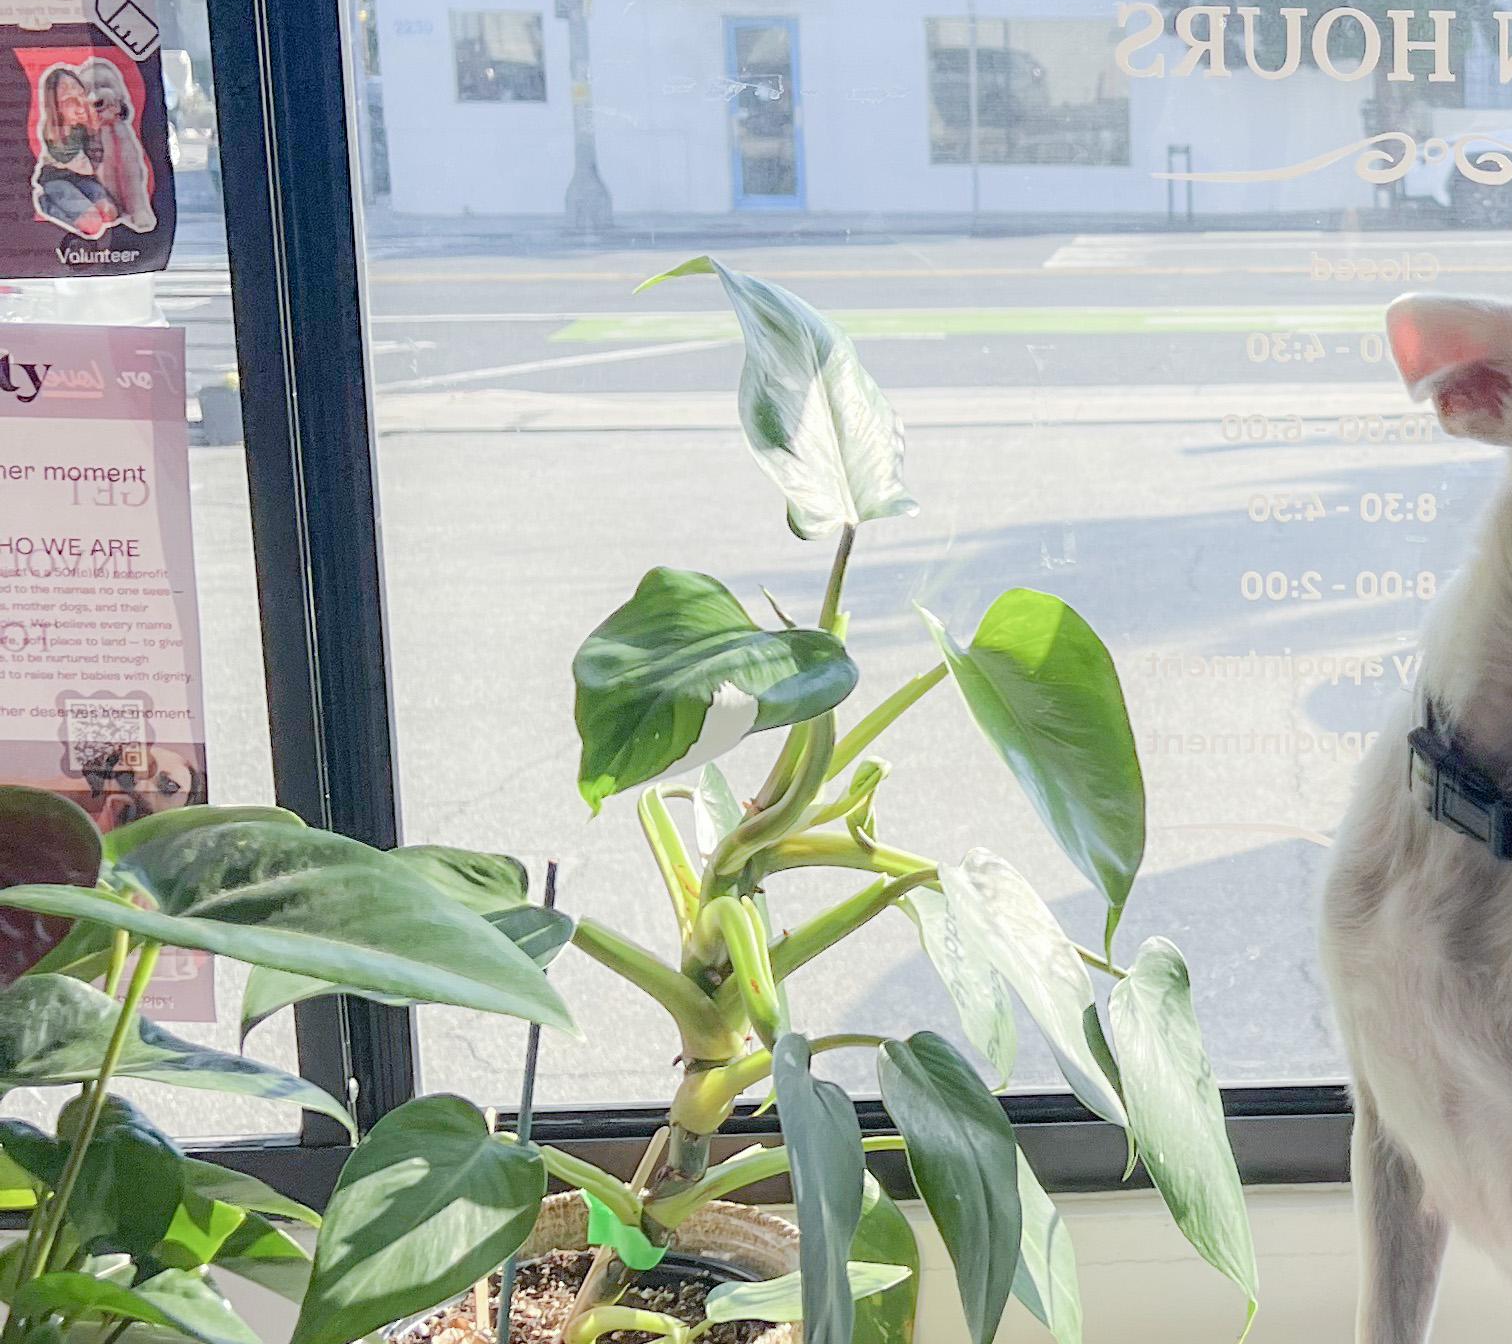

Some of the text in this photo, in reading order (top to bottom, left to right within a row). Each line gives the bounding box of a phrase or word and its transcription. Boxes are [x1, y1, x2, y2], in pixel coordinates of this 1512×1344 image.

[55, 247, 141, 265] Volunteer
[43, 464, 147, 483] moment
[41, 537, 82, 556] WE
[90, 538, 142, 557] ARE
